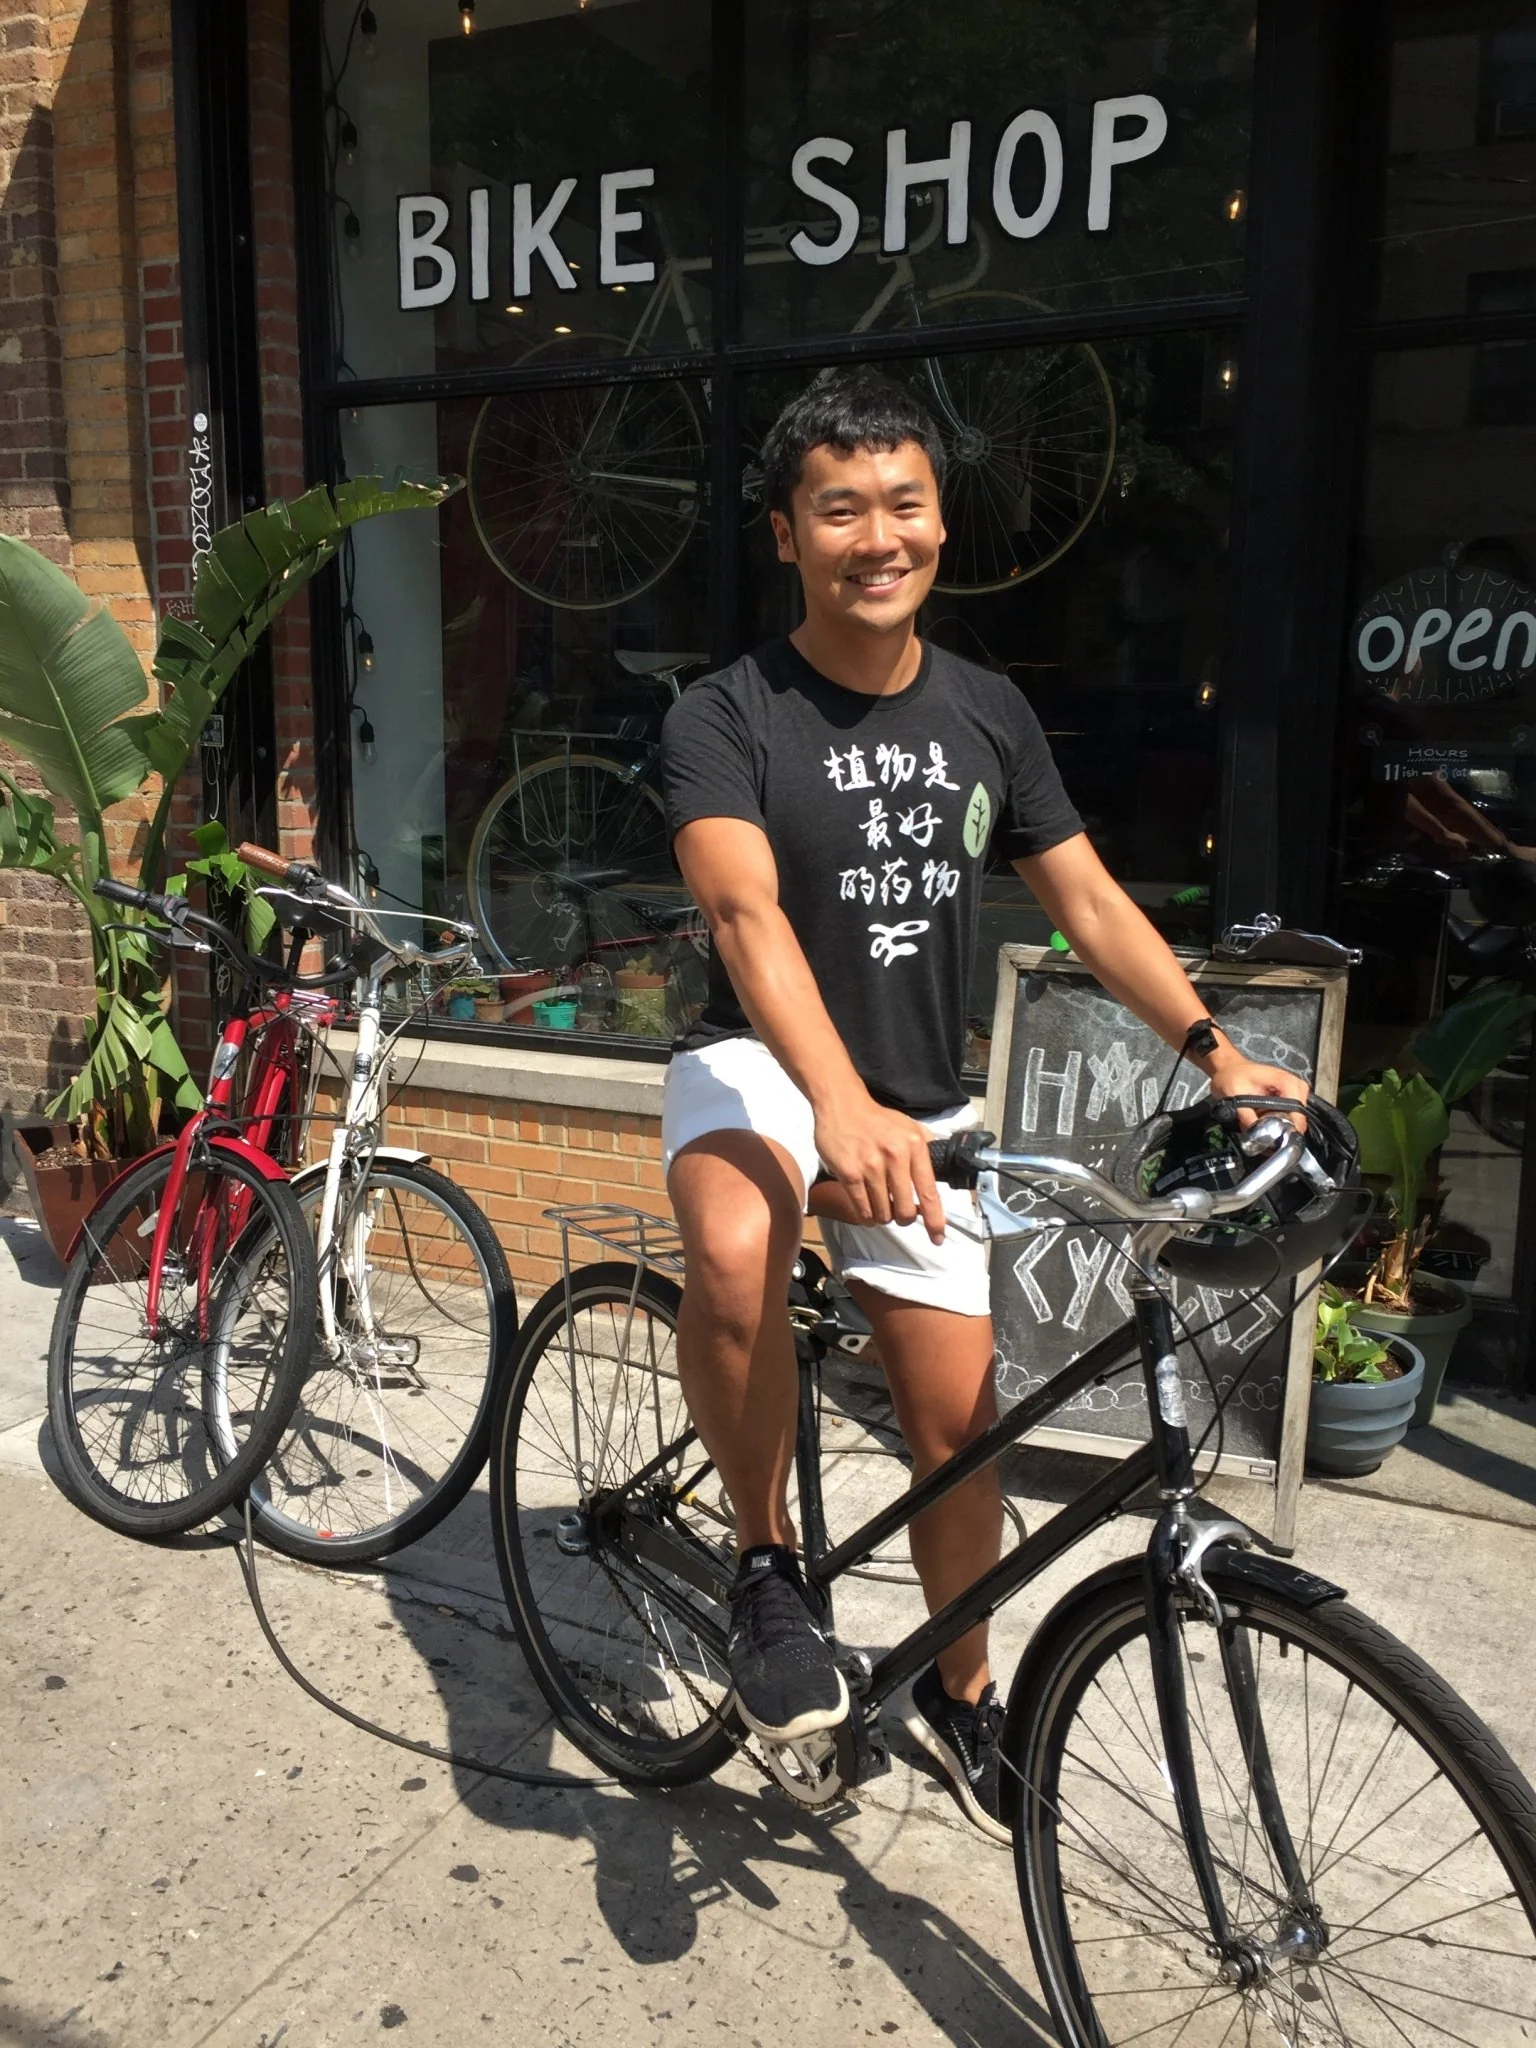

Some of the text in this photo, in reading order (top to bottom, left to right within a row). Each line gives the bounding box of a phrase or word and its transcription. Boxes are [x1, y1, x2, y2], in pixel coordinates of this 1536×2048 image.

[399, 94, 1168, 313] BIKE SHOP
[823, 741, 961, 792] 植物是
[1408, 748, 1468, 758] HOURS
[1436, 763, 1448, 782] 8
[858, 797, 943, 851] 最好
[838, 856, 961, 906] 的药物
[751, 1553, 773, 1569] NIKE
